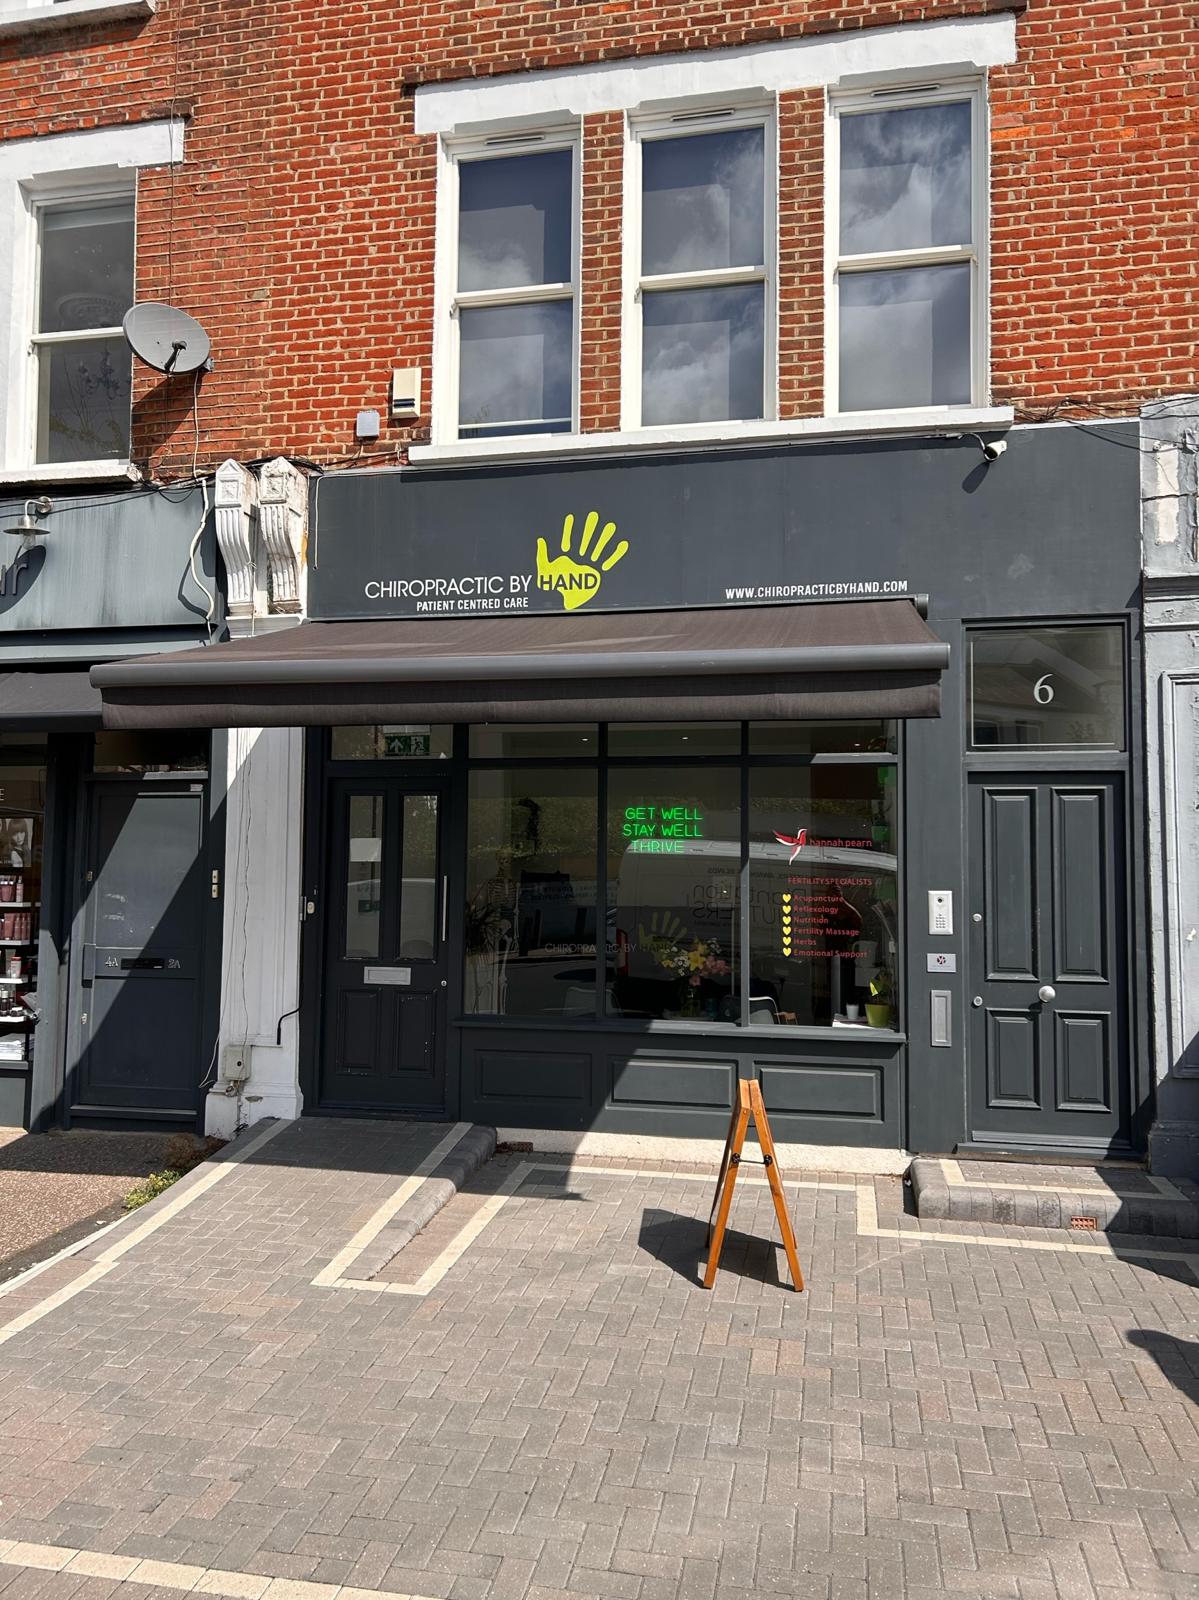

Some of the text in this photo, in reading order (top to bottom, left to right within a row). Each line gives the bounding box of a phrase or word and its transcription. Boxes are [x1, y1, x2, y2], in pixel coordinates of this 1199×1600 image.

[365, 573, 598, 599] CHIROPRACTIC BY HAND
[725, 580, 908, 599] WWW.CHIROPRACTICBYHAND.COM
[416, 597, 529, 612] PATIENT CENTRED CARE
[1033, 673, 1054, 704] 6
[625, 807, 704, 820] GET WELL
[622, 823, 703, 837] STAY WELL
[631, 840, 685, 853] THRIVE
[809, 838, 873, 848] hannah pearn
[793, 905, 839, 914] Reflexology
[793, 916, 829, 924] Nutrition
[793, 927, 860, 937] Fertility Massage
[793, 938, 817, 946] Herbs
[544, 943, 620, 954] CHIROPRATIC
[793, 948, 868, 958] Emotional Support
